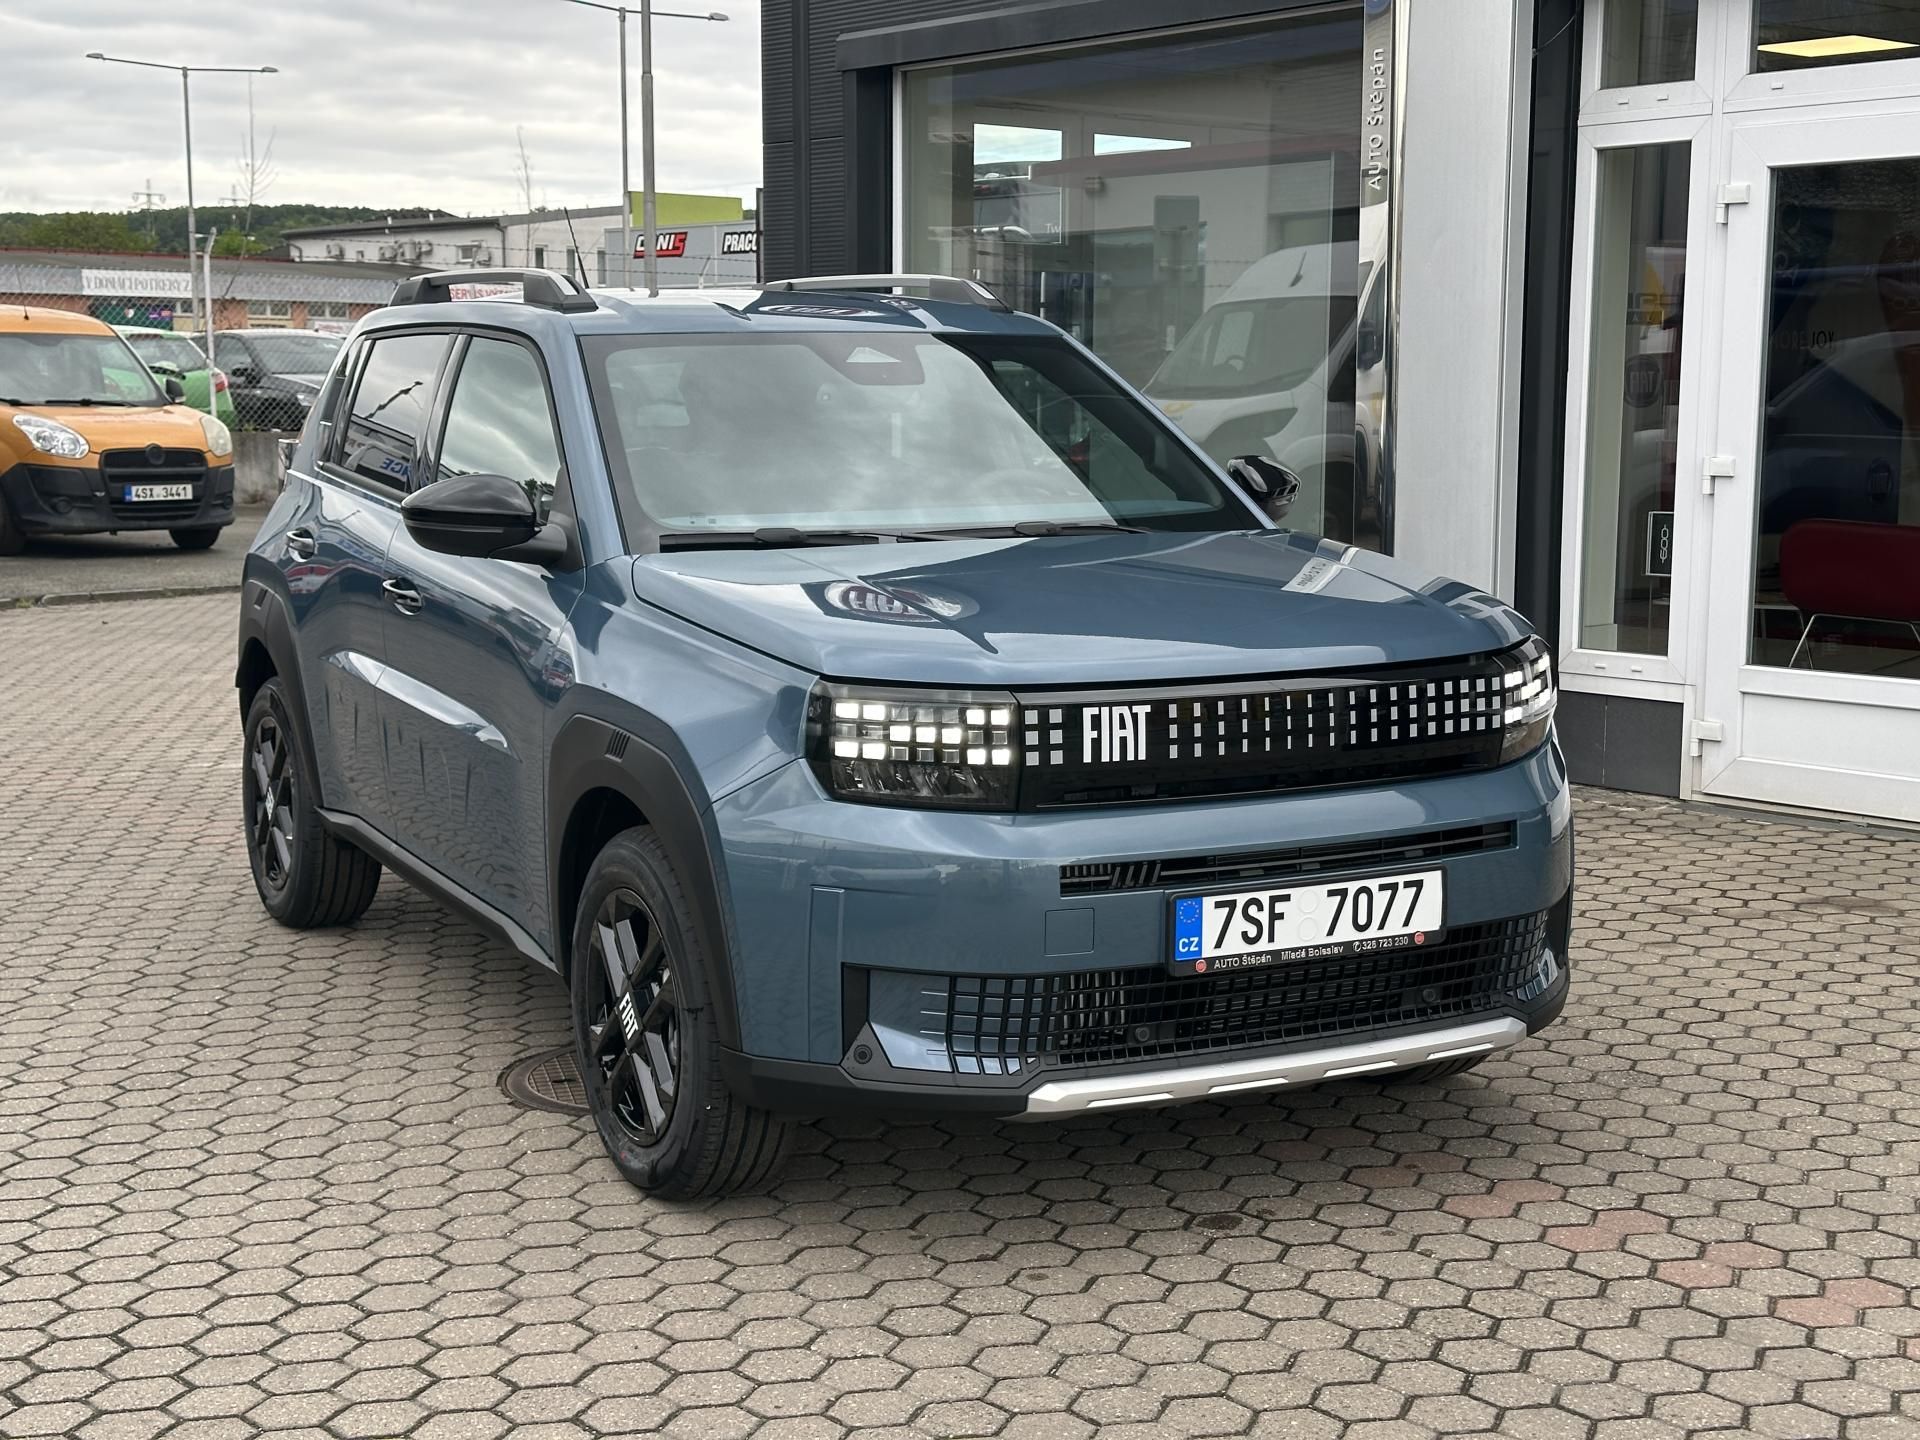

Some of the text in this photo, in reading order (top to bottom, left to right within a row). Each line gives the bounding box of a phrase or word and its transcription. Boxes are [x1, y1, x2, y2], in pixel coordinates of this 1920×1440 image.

[1366, 48, 1387, 190] AUTO Štěpán
[1810, 330, 1835, 350] JOY
[134, 488, 154, 499] 4SX
[162, 486, 187, 498] 3441
[1083, 704, 1151, 763] FIAT
[1213, 879, 1424, 949] 7SF 7077
[1178, 937, 1199, 953] CZ
[1213, 957, 1240, 969] AUTO
[1241, 953, 1272, 969] Štěpán
[1281, 946, 1306, 961] Mladá
[1308, 944, 1344, 959] Boleslav
[1378, 938, 1393, 949] 723
[1394, 936, 1409, 947] 230
[619, 991, 639, 1040] FIAT
